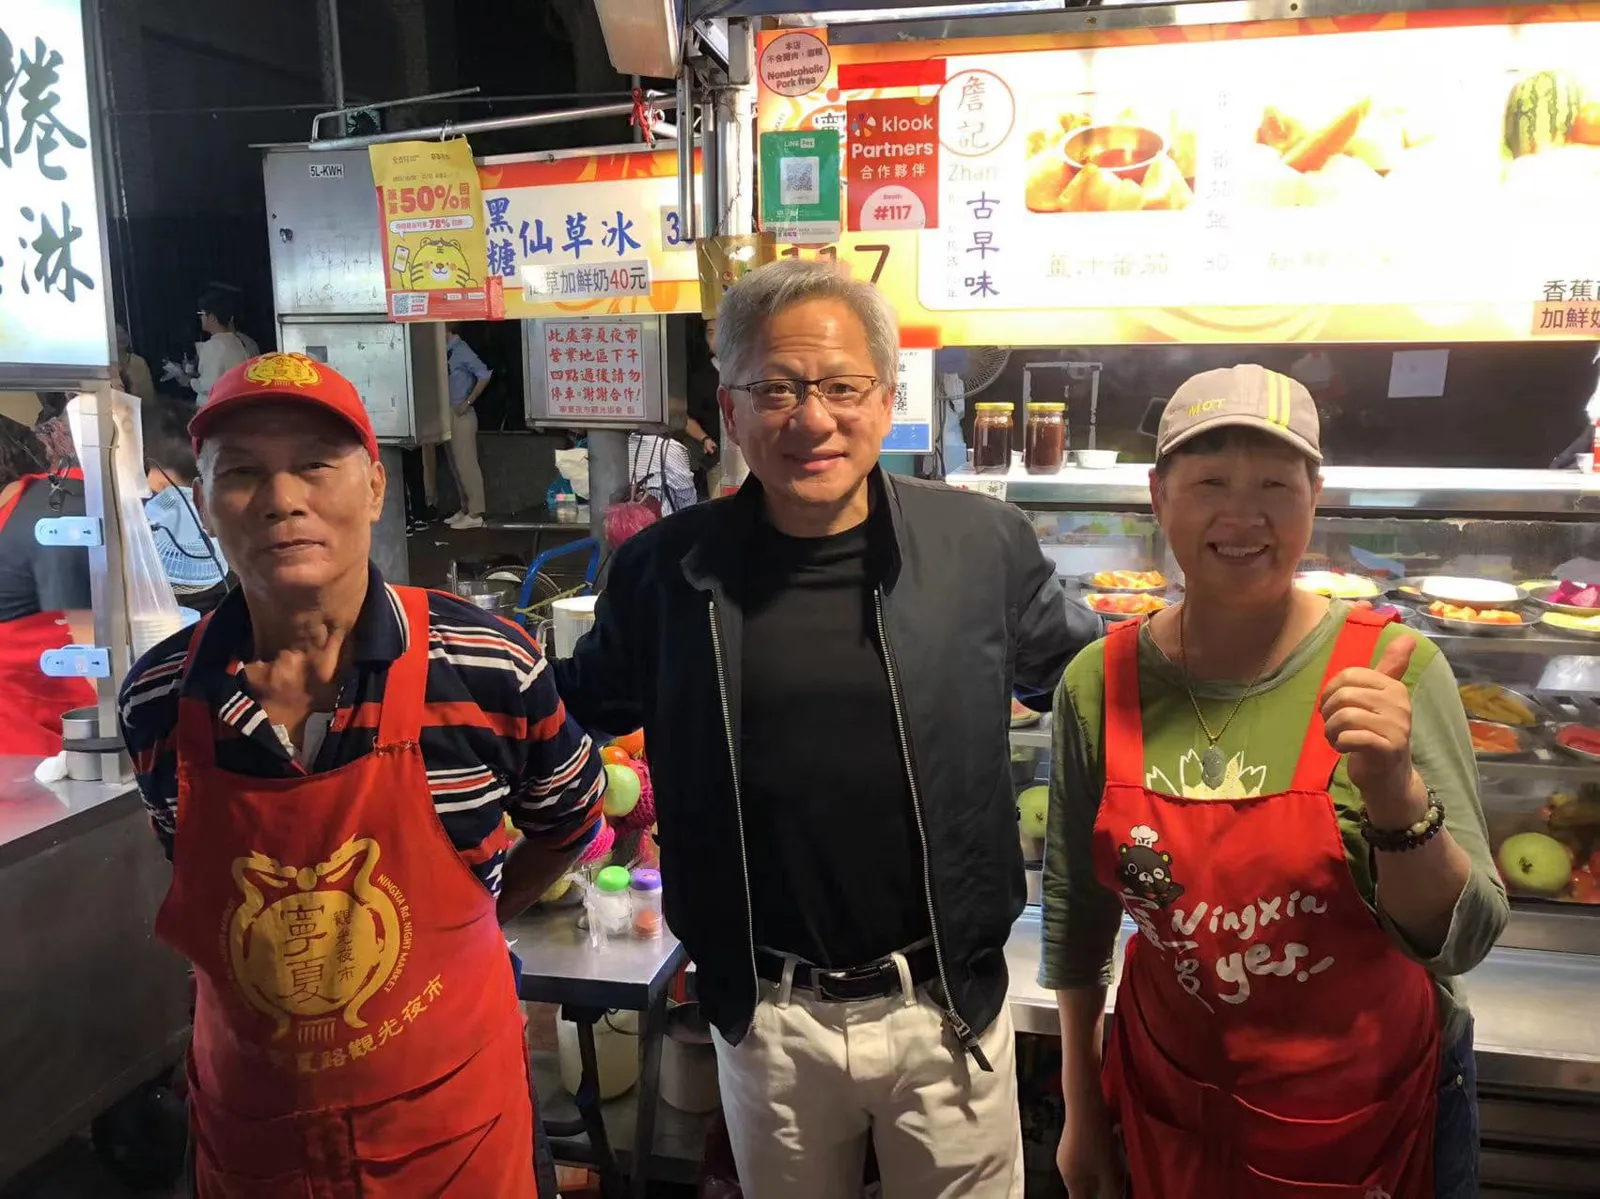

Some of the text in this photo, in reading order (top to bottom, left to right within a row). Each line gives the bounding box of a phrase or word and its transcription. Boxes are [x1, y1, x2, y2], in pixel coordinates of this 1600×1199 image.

[784, 40, 801, 51] 本店
[767, 64, 824, 81] Nonalcoholic
[776, 75, 816, 89] Pork free
[957, 75, 989, 150] 詹記
[882, 115, 933, 133] klook
[851, 141, 934, 159] Partners
[860, 162, 926, 180] 合作夥伴
[947, 163, 998, 183] Zhan
[400, 184, 459, 213] 50%
[874, 204, 912, 221] #117
[428, 218, 451, 230] 78%
[485, 197, 517, 278] 黑糖
[519, 210, 642, 260] 仙草冰
[964, 190, 1000, 298] 古早味
[1543, 278, 1600, 303] 香蕉
[548, 327, 639, 344] 此處寧夏夜市
[549, 348, 639, 363] 營業地區下午
[550, 368, 641, 384] 四點過後請勿
[376, 873, 404, 905] NINGXIA
[333, 907, 357, 983] 觀光夜市
[402, 921, 413, 951] NIGHT
[277, 903, 340, 1004] 寧夏
[383, 951, 409, 993] MARKET
